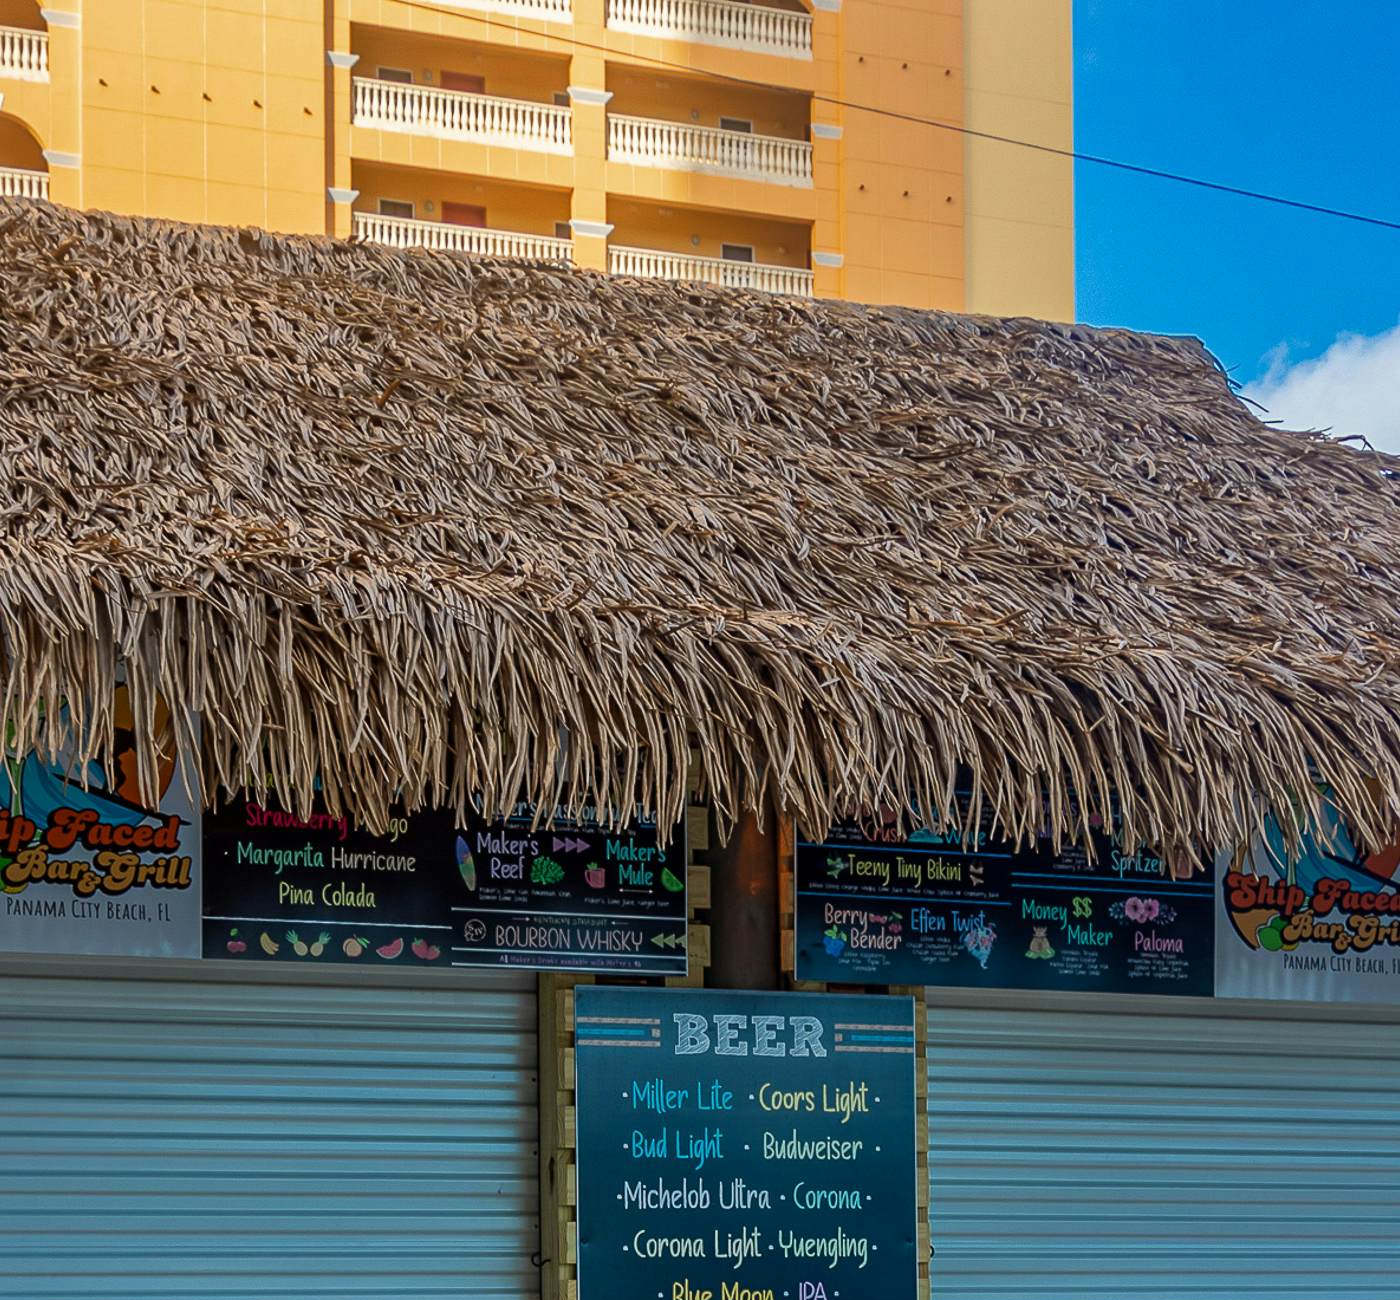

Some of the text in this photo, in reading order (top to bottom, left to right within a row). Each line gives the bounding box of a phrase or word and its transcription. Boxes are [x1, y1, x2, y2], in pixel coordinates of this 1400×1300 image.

[46, 808, 179, 849] Faced
[6, 845, 88, 882] Bar
[97, 852, 190, 891] Grill
[237, 841, 416, 874] Margarita Hurricane
[490, 855, 525, 880] Reef
[848, 854, 961, 888] Teeny Tiny Bikini
[618, 863, 653, 886] Mule
[7, 897, 171, 922] PANAMA CITY BEACH, FL
[279, 881, 376, 908] Pina Colada
[1227, 872, 1305, 915] Ship
[824, 903, 868, 934] Berry
[911, 907, 985, 932] Effen Twist
[1022, 898, 1067, 930] Money
[1283, 911, 1343, 940] Bar
[1350, 915, 1400, 949] Gri
[495, 925, 643, 952] BOURBON WHISKY
[850, 927, 902, 950] Bender
[1067, 923, 1113, 946] Maker
[1134, 930, 1184, 953] Paloma
[1284, 955, 1327, 971] PANAMA
[1330, 956, 1351, 972] CITY
[1356, 957, 1388, 975] BEACH,
[673, 1013, 827, 1057] BEER
[632, 1078, 733, 1113] Miller Lite
[759, 1081, 868, 1123] Coors Light
[632, 1127, 724, 1170] Bud Light
[764, 1129, 862, 1159] Budweiser
[624, 1177, 770, 1209] Michelob Ultra
[794, 1182, 862, 1209] Corona
[634, 1227, 762, 1269] Corona Light
[779, 1227, 867, 1268] Yuengling
